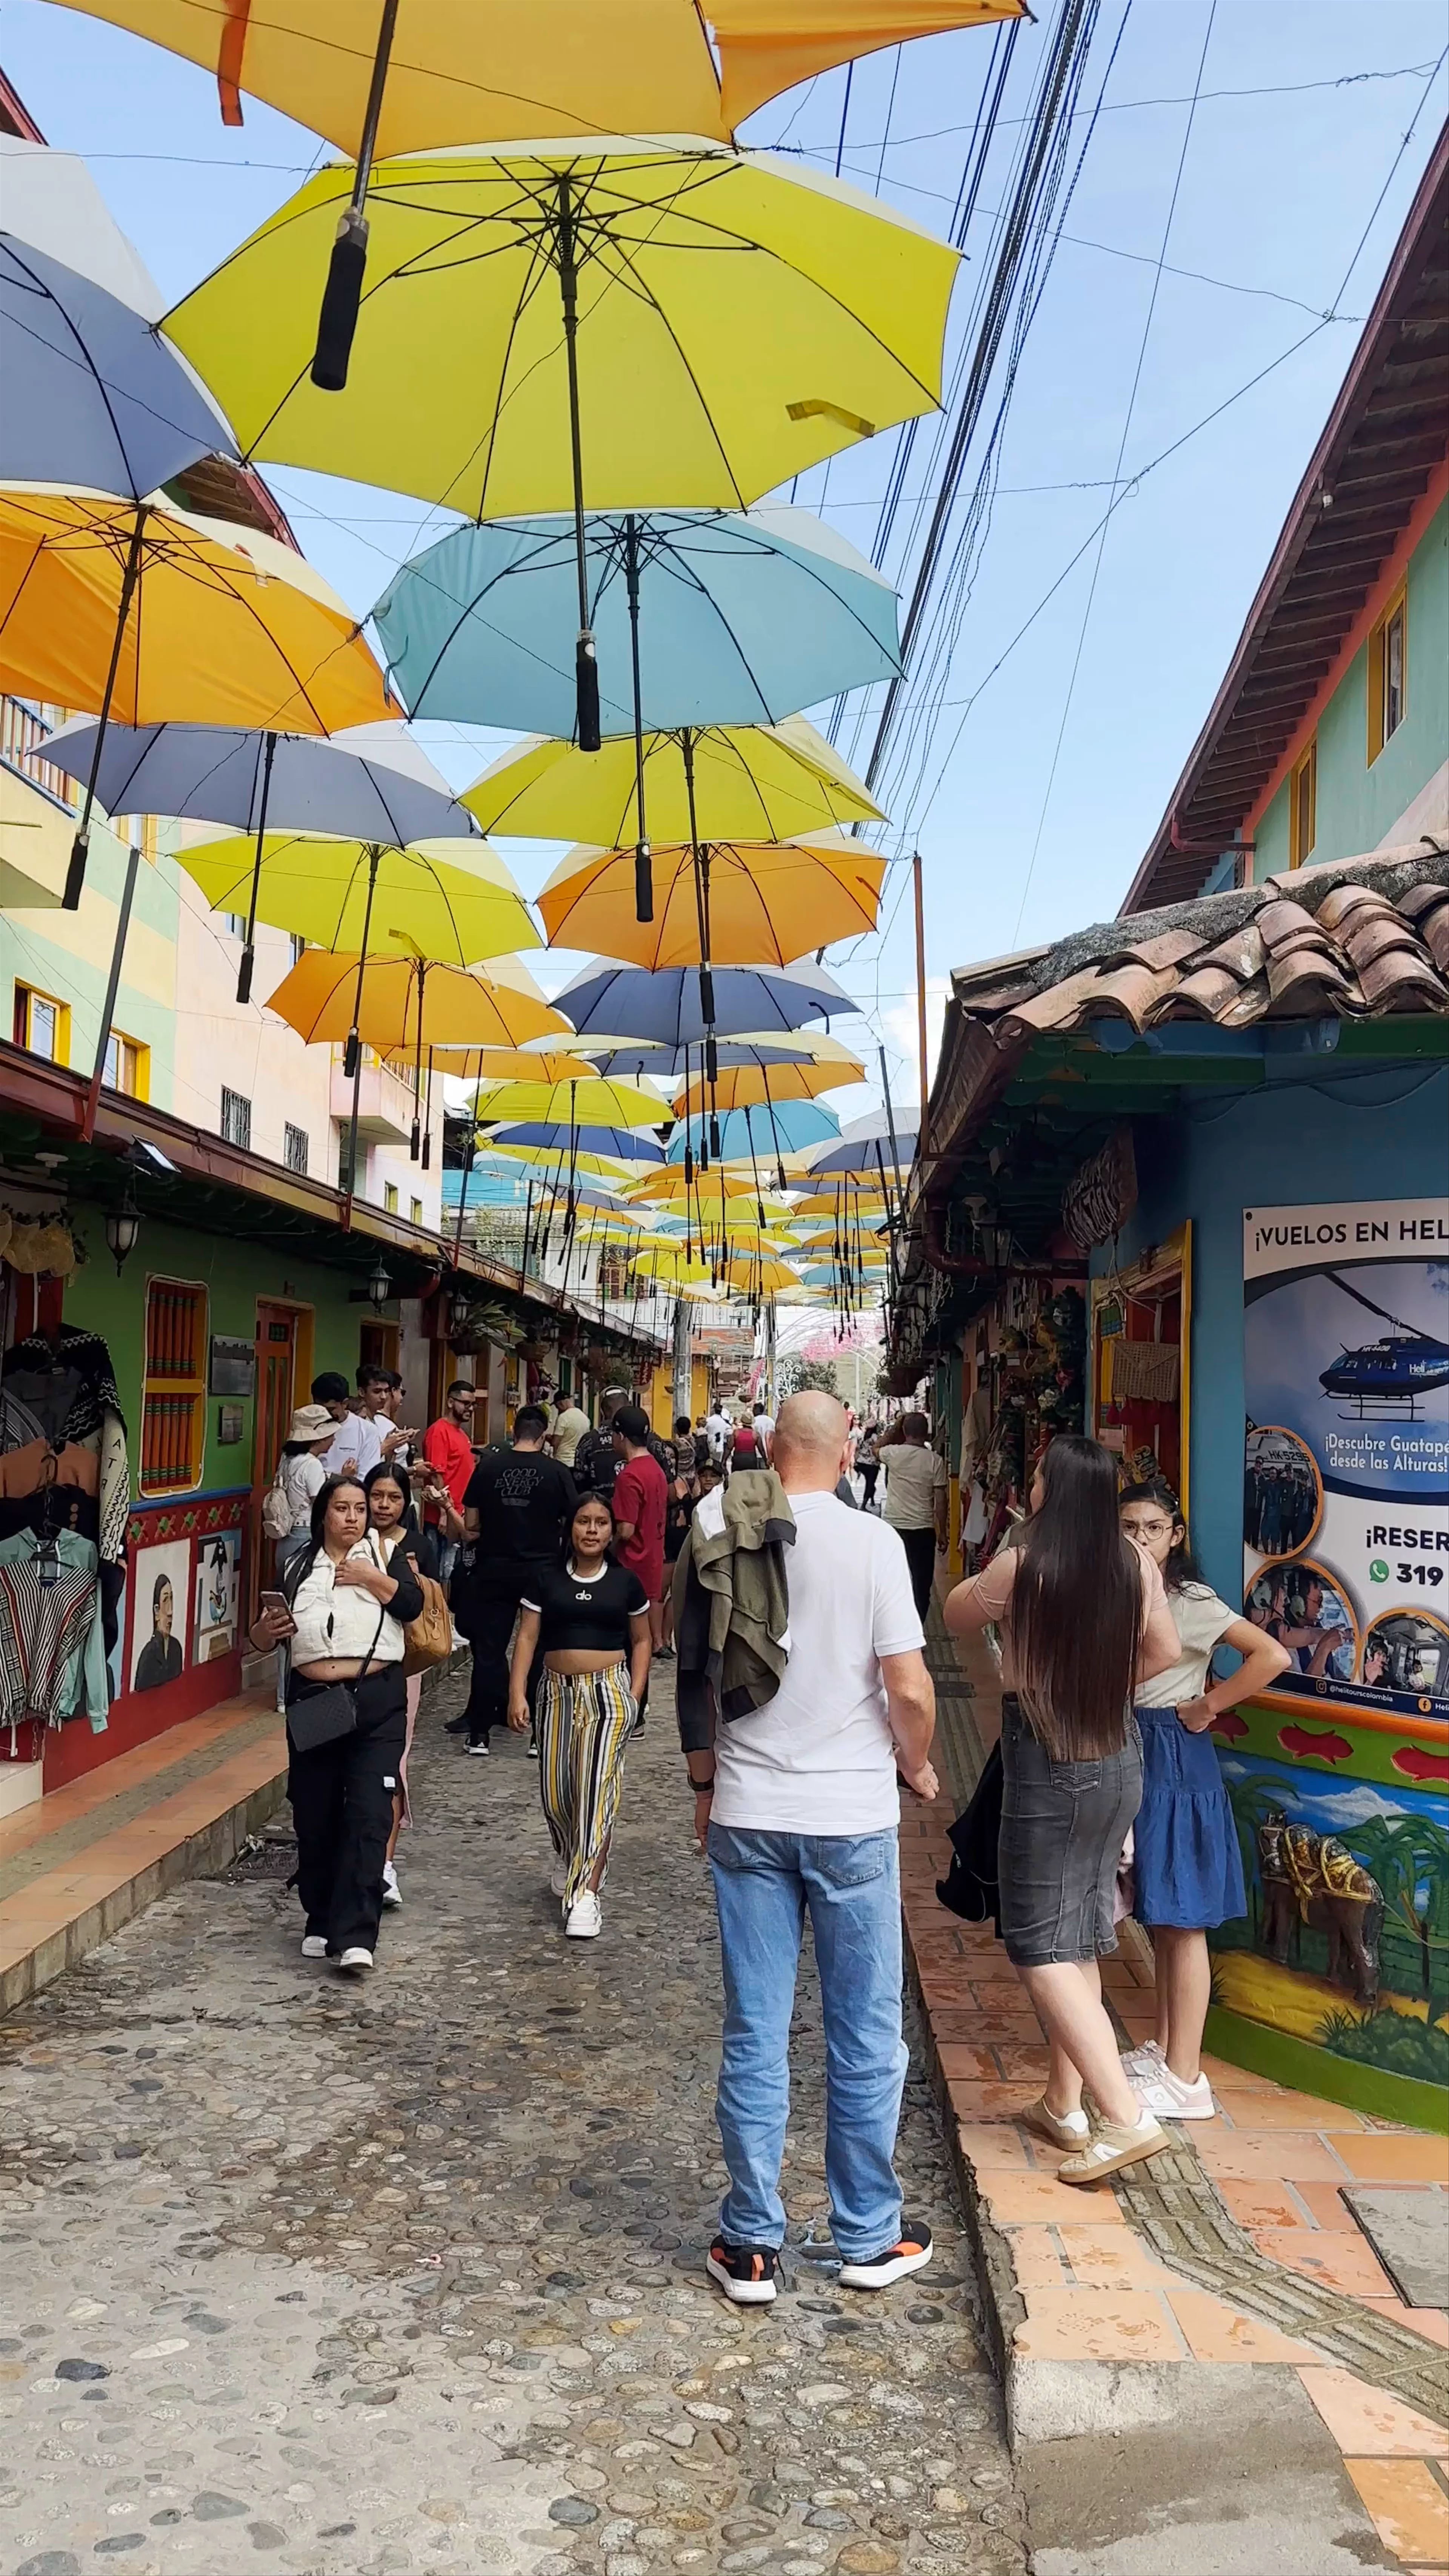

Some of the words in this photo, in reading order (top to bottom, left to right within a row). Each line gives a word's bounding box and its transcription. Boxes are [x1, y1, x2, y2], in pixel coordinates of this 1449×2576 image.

[1255, 1223, 1347, 1252] ¡VUELOS
[1355, 1221, 1389, 1242] EN
[1400, 1219, 1449, 1240] HEL
[1325, 1433, 1386, 1452] ¡Descubre
[1330, 1450, 1366, 1469] desde
[1370, 1452, 1389, 1469] las
[1393, 1453, 1448, 1473] Alturas!
[502, 1468, 537, 1478] GOOD
[501, 1486, 532, 1497] CLUB
[1366, 1525, 1449, 1552] ¡RESER
[1396, 1563, 1444, 1586] 319
[575, 1589, 592, 1601] alo
